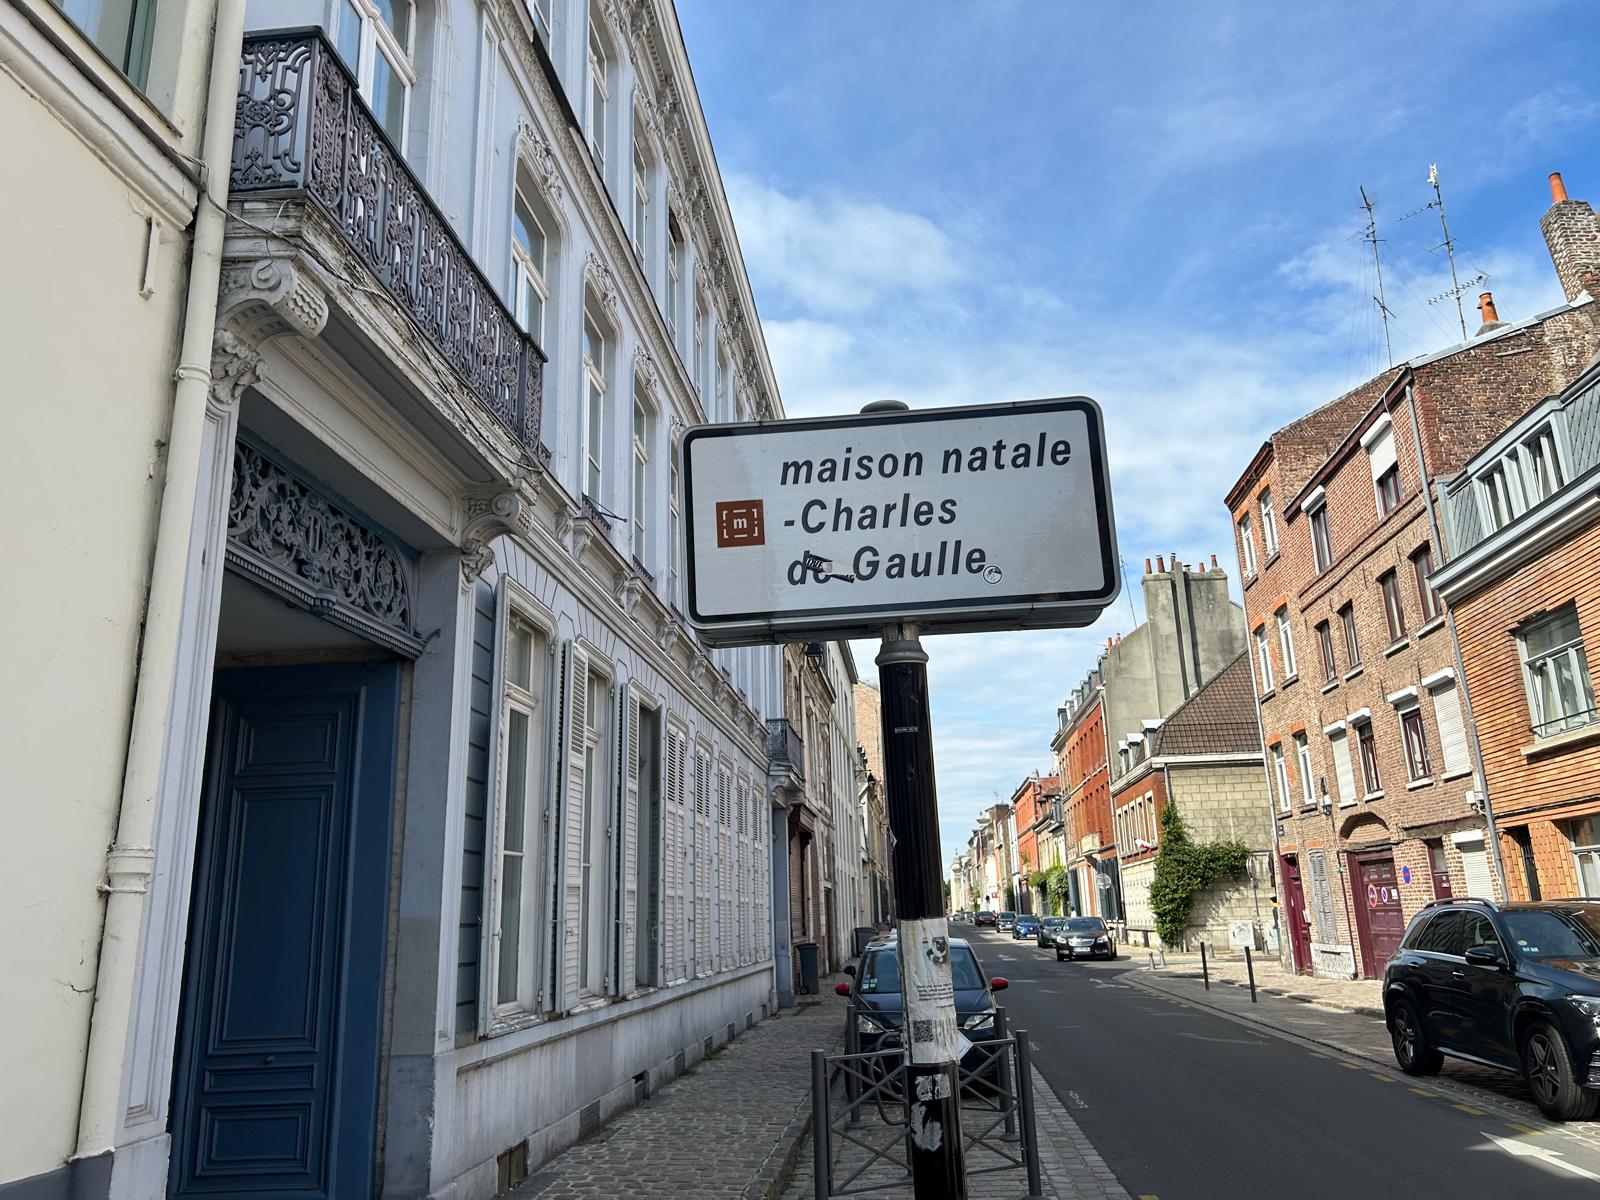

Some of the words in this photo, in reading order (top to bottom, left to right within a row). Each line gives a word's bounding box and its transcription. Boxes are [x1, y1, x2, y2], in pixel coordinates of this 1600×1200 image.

[780, 447, 923, 485] maison
[941, 432, 1071, 474] natale
[852, 540, 986, 581] Gaulle
